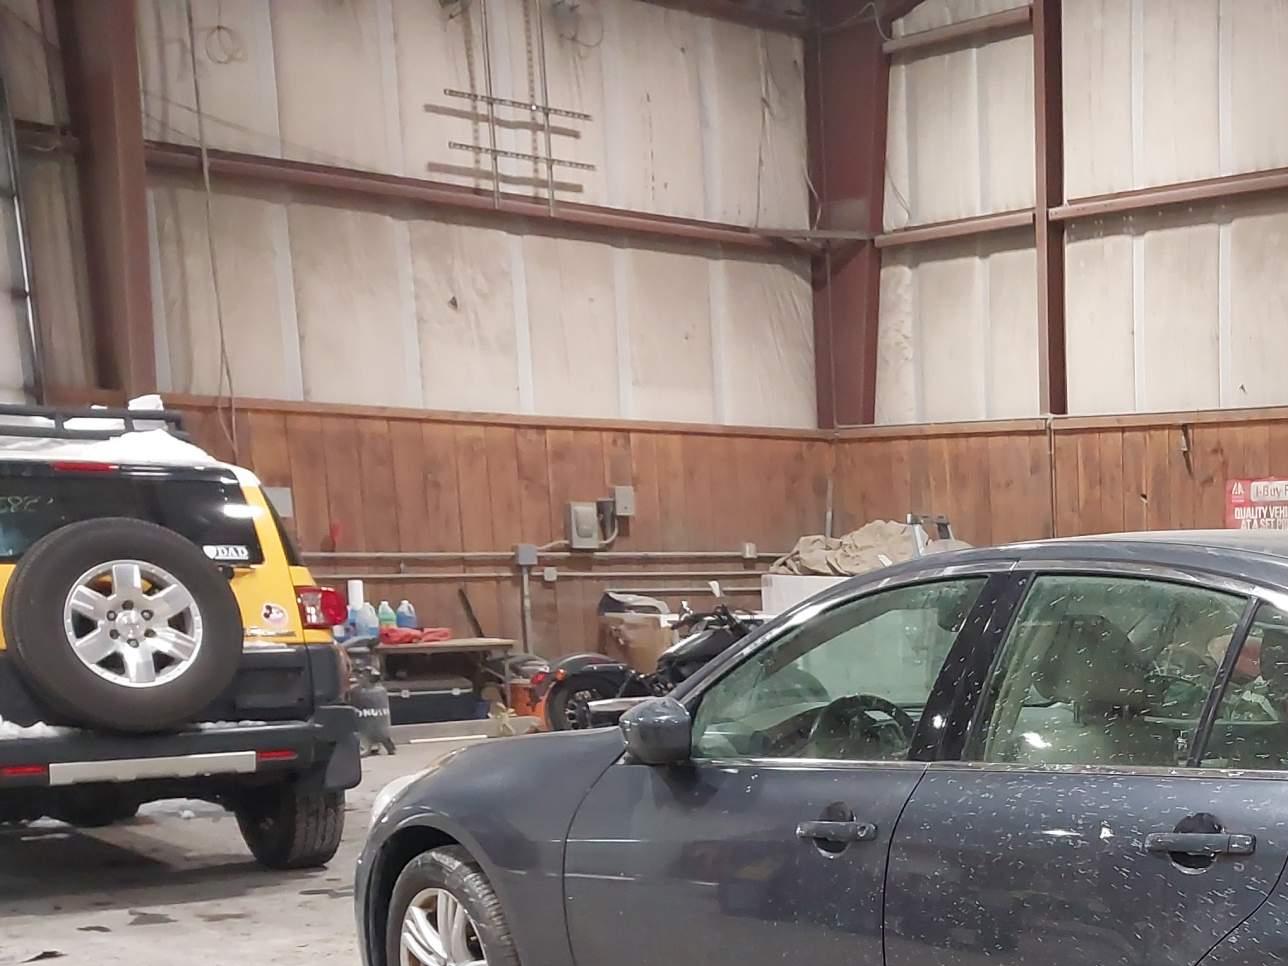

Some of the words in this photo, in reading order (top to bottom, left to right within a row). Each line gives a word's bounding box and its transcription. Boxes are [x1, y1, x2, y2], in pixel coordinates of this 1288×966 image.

[1234, 506, 1268, 519] QUALITY
[1241, 519, 1252, 529] AT
[1252, 519, 1258, 529] A
[1260, 519, 1275, 529] SET
[216, 546, 249, 558] DAD
